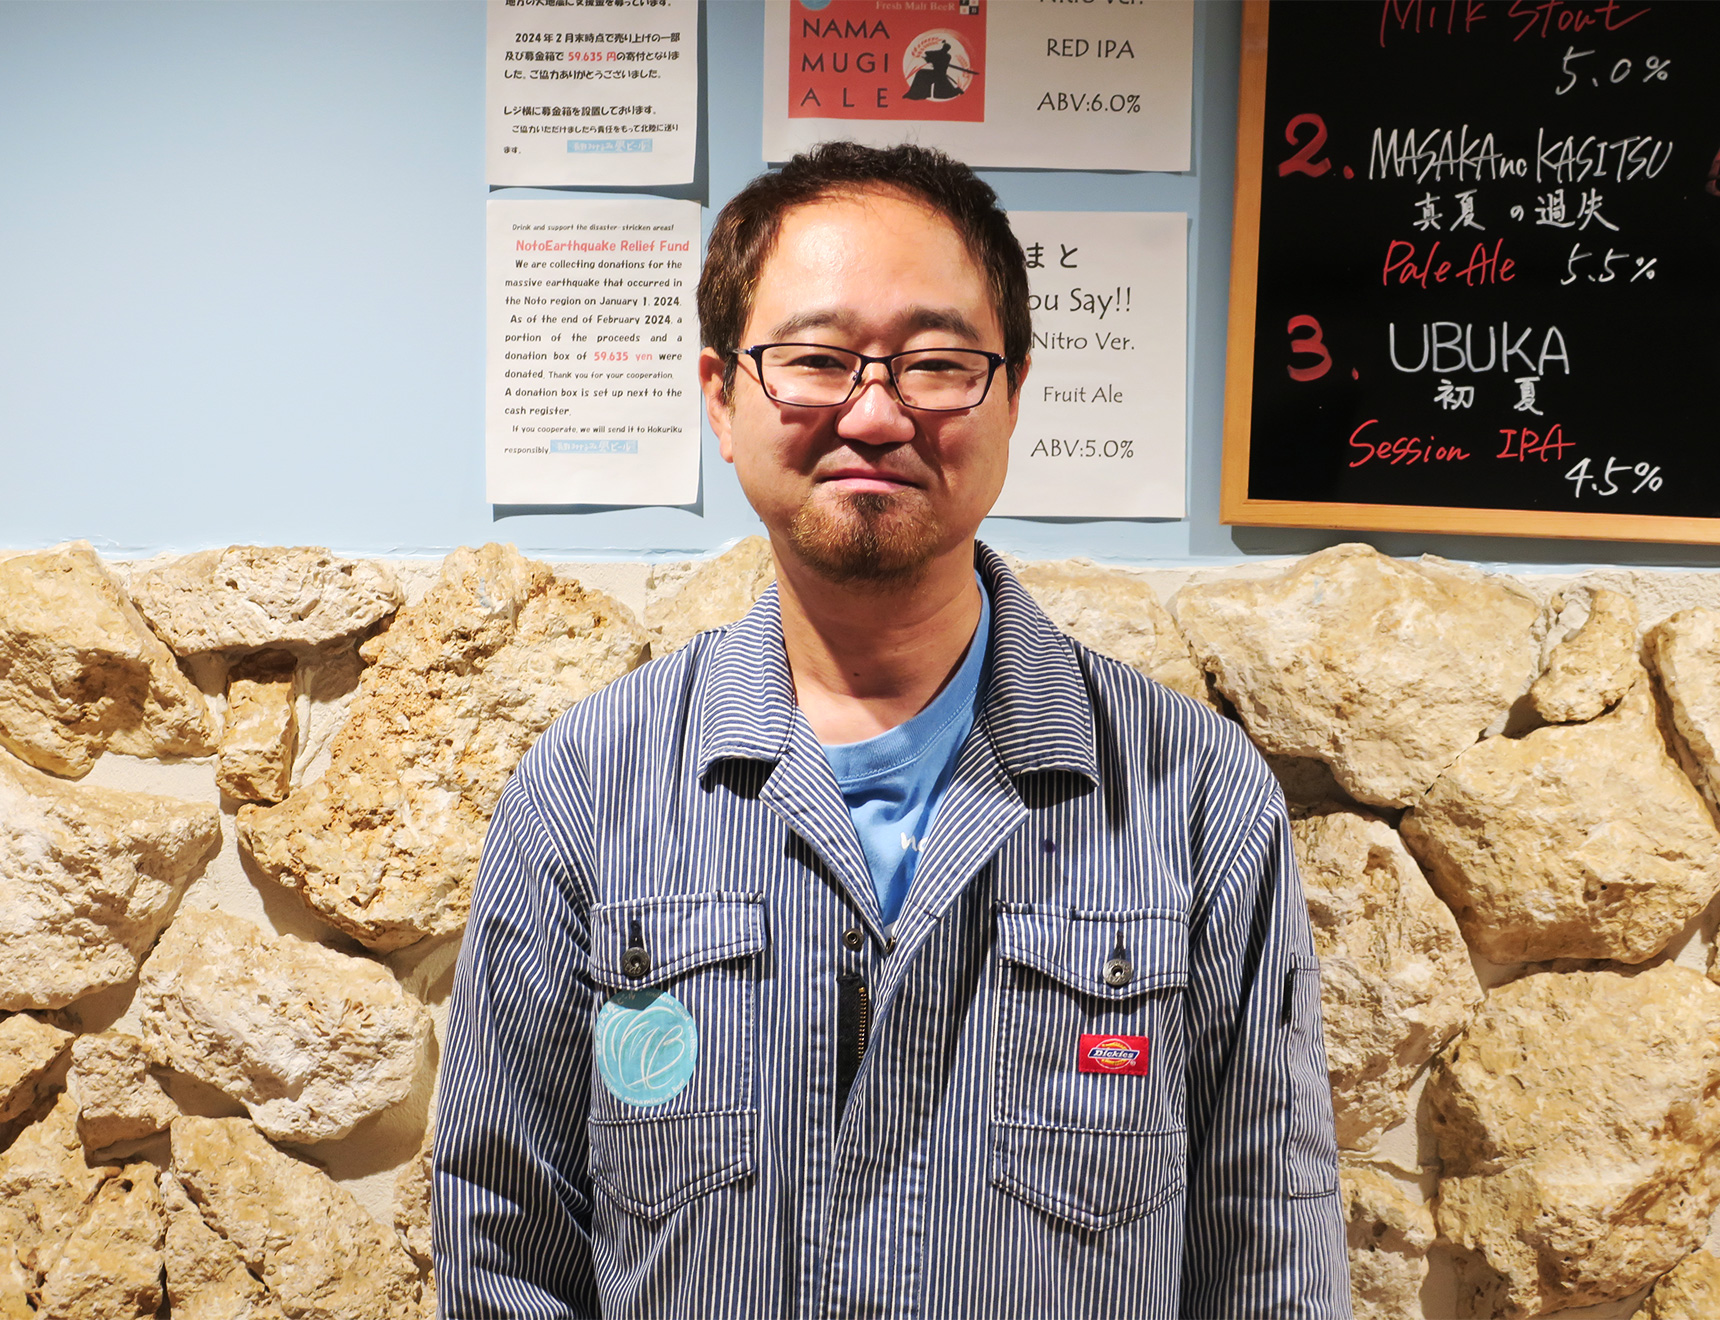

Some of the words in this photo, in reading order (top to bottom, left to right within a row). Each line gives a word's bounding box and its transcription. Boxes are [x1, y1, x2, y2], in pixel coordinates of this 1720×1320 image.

[802, 19, 890, 39] NAMA
[1379, 0, 1487, 47] Milk
[1508, 0, 1652, 42] Stout
[1047, 39, 1089, 58] RED
[1097, 39, 1135, 58] IPA
[802, 52, 889, 73] MUGI
[1037, 92, 1141, 113] ABV:6.0%
[1279, 113, 1355, 179] 2.
[621, 240, 655, 251] Relief
[660, 240, 689, 251] Fund
[516, 260, 528, 268] We
[550, 260, 595, 269] collecting
[598, 260, 645, 268] donations
[648, 260, 663, 269] for
[667, 260, 682, 268] the
[1382, 239, 1452, 288] Pale
[1456, 239, 1516, 288] Ale
[505, 278, 542, 286] massive
[546, 278, 599, 287] earthquake
[604, 278, 623, 286] that
[627, 279, 670, 287] occurred
[674, 278, 682, 287] in
[506, 296, 520, 305] the
[524, 296, 547, 305] Noto
[550, 297, 581, 306] region
[600, 297, 638, 306] January
[1029, 294, 1058, 311] ou
[1070, 286, 1132, 320] Say!!
[510, 315, 522, 323] As
[527, 315, 537, 323] of
[542, 315, 557, 323] the
[561, 315, 578, 323] end
[583, 315, 592, 323] of
[597, 315, 640, 324] February
[505, 333, 541, 342] portion
[551, 333, 561, 341] of
[572, 333, 587, 342] the
[597, 333, 640, 343] proceeds
[651, 333, 667, 342] and
[1032, 332, 1088, 350] Nitro
[1095, 332, 1134, 350] Ver.
[505, 351, 547, 360] donation
[554, 352, 569, 360] box
[577, 352, 586, 360] of
[1287, 314, 1359, 382] 3.
[1389, 321, 1570, 375] UBUKA
[505, 388, 511, 396] A
[515, 388, 557, 396] donation
[561, 388, 577, 396] box
[581, 388, 589, 396] is
[594, 388, 608, 397] set
[627, 388, 648, 397] next
[653, 389, 662, 397] to
[667, 388, 682, 397] the
[1044, 386, 1086, 403] Fruit
[1092, 384, 1123, 403] Ale
[505, 406, 526, 414] cash
[1030, 438, 1134, 459] ABV:5.0%
[1349, 420, 1470, 468] Session
[1496, 424, 1576, 463] IPA
[1565, 458, 1663, 498] 4.5%
[1094, 1050, 1134, 1058] Dickies
